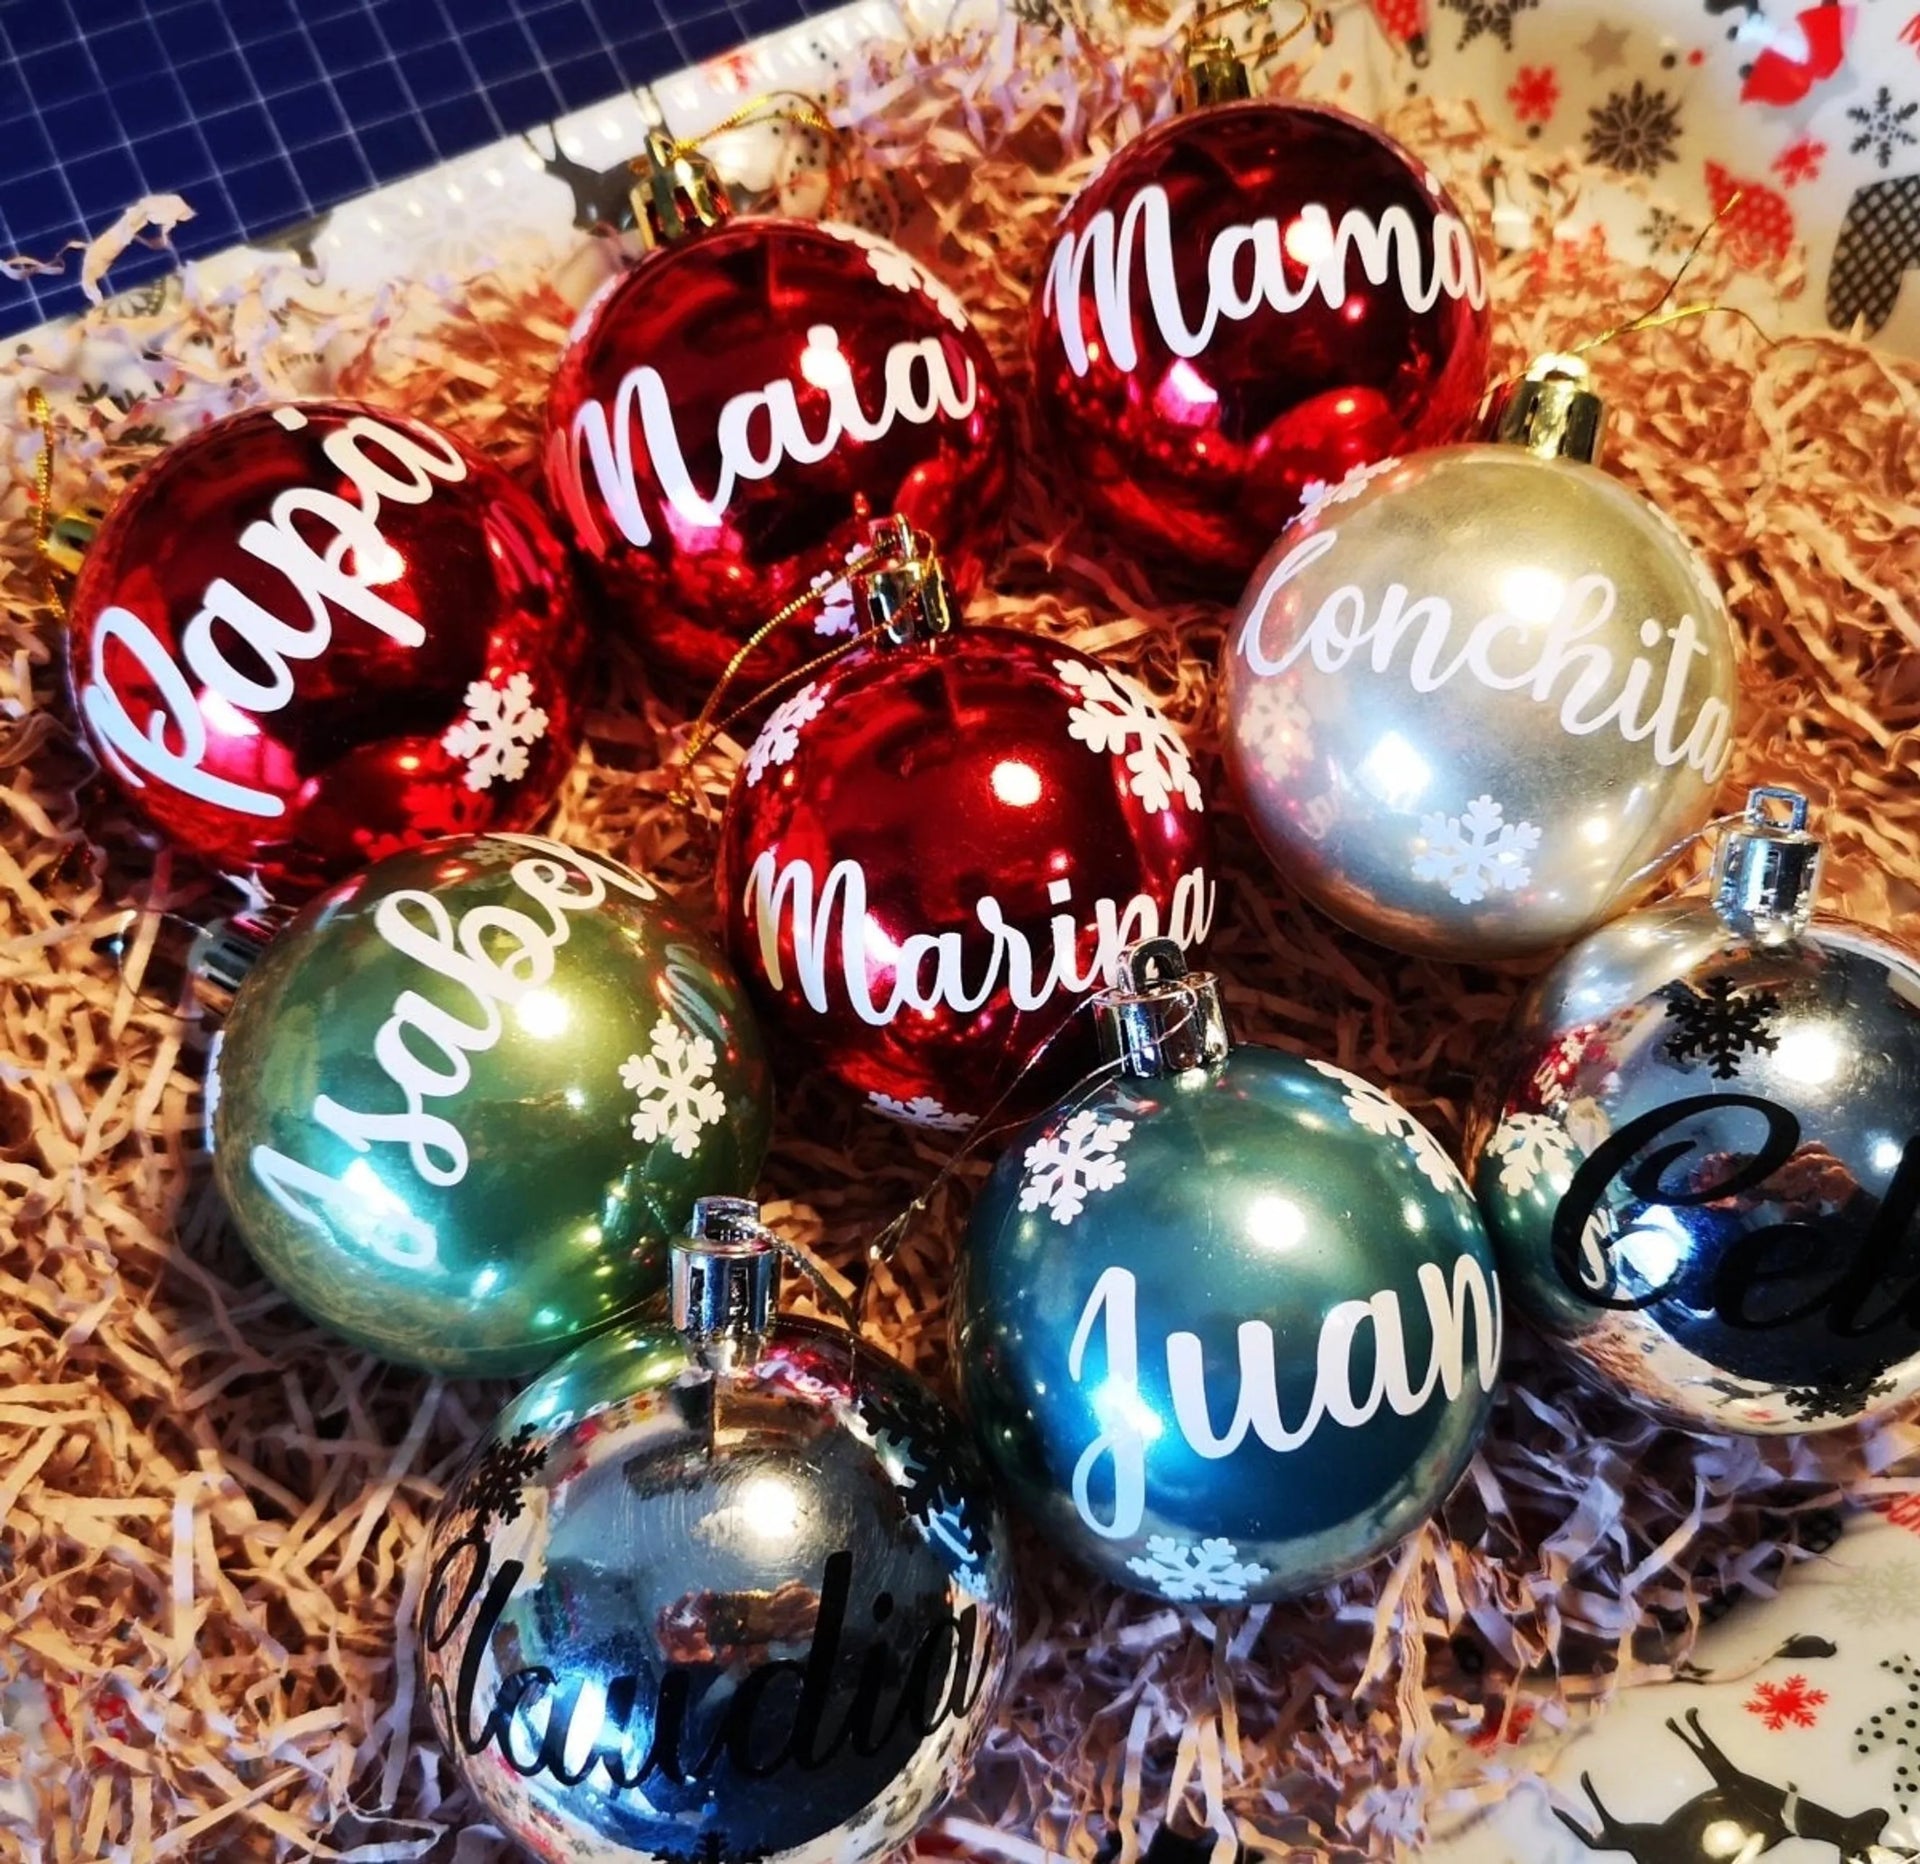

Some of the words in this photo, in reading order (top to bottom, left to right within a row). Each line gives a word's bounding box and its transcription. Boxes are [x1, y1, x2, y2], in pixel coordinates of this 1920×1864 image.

[1236, 530, 1733, 784] Conchita
[249, 832, 658, 1270] Isabel
[743, 848, 1216, 1027] Marina
[1551, 1092, 1920, 1338] Cel
[1067, 1253, 1503, 1540] Juan
[420, 1536, 994, 1786] Claudia
